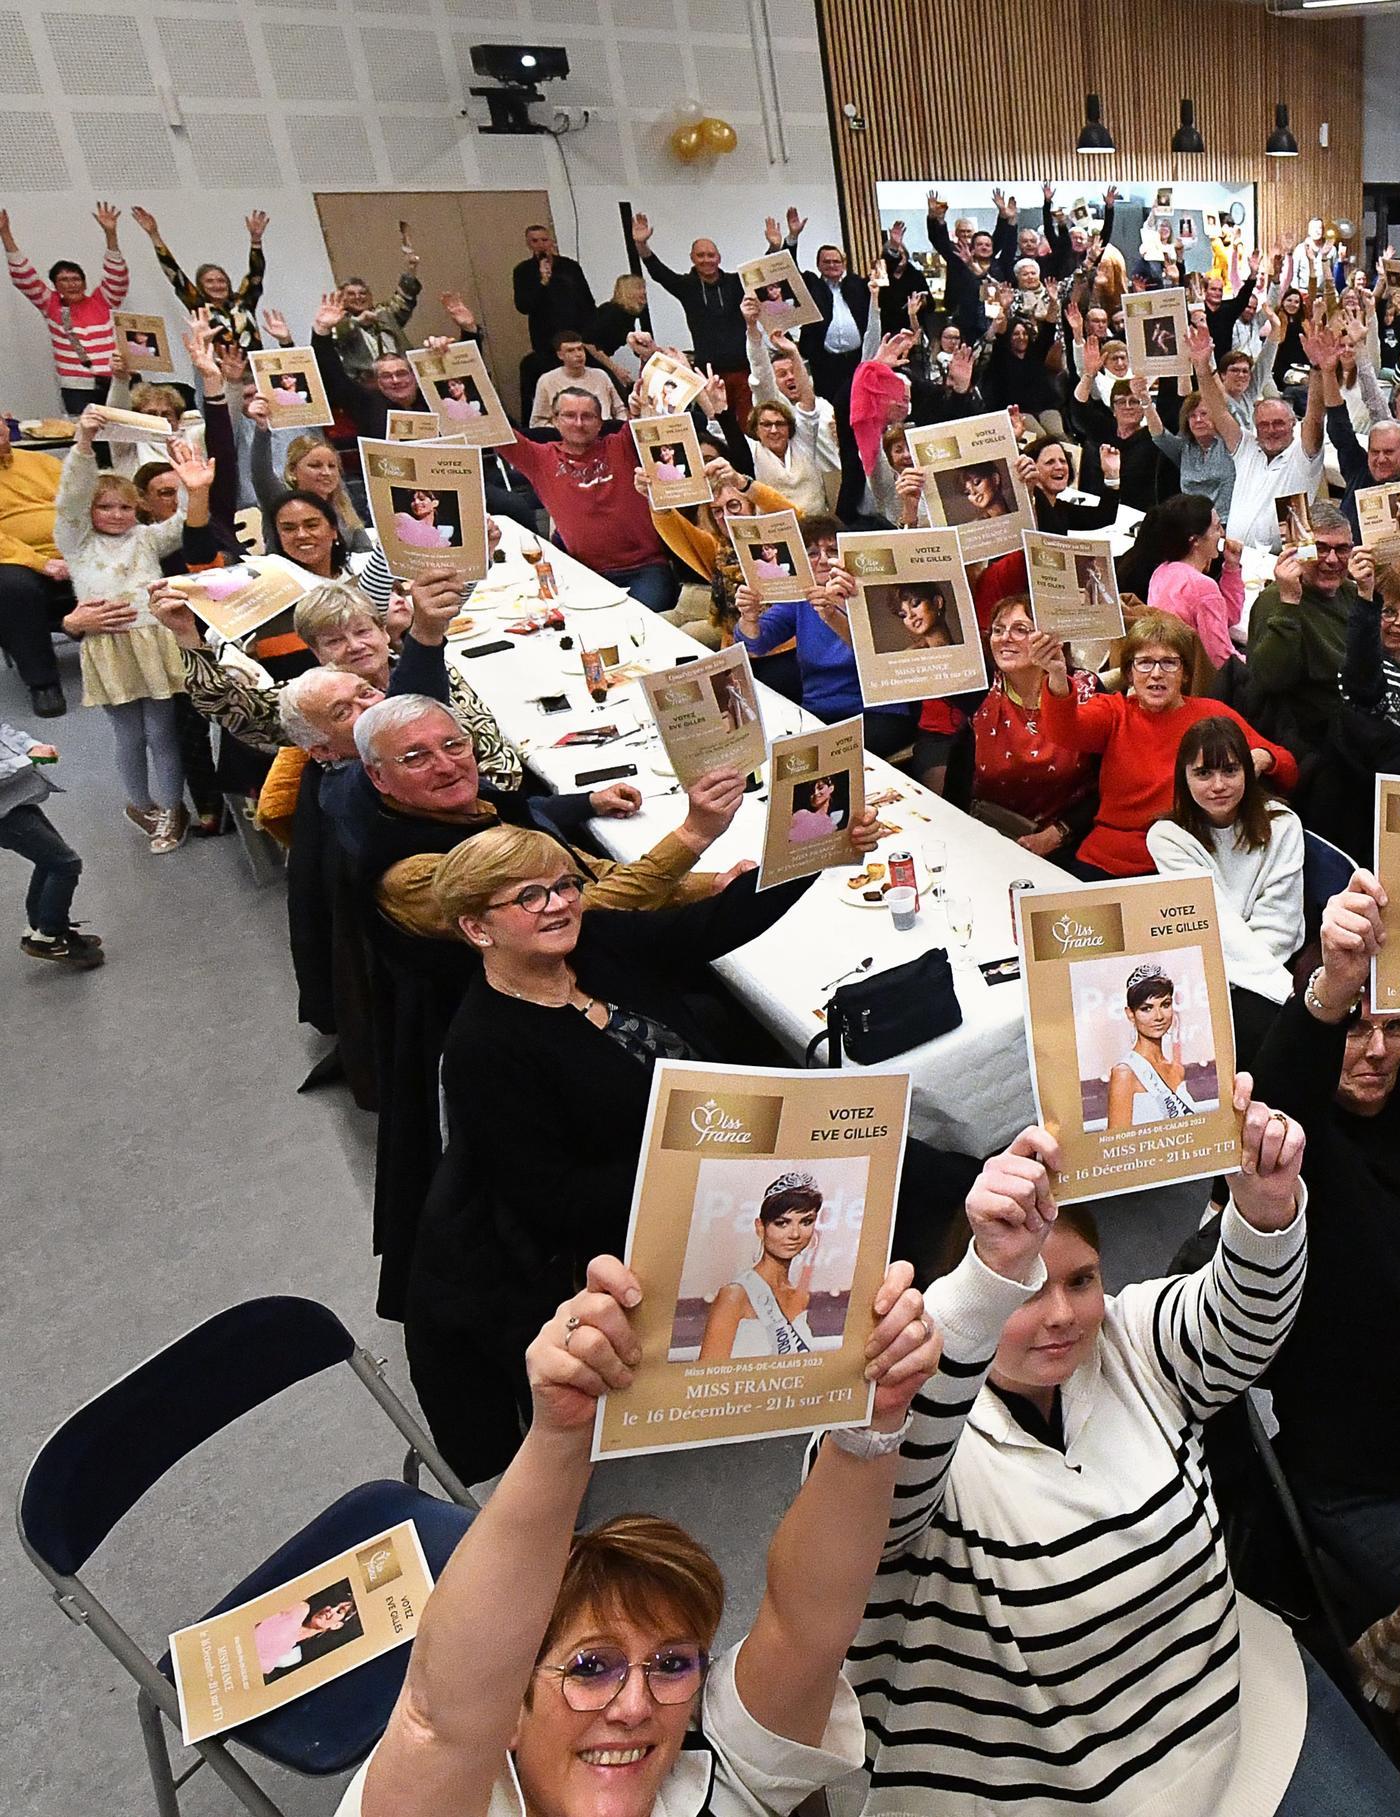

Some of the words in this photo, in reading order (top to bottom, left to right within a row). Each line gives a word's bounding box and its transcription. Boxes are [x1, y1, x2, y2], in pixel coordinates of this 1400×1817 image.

[926, 555, 952, 563] GILLES
[1159, 905, 1195, 919] VOTEZ
[1052, 919, 1095, 942] Miss
[1150, 925, 1174, 937] EVE
[1176, 920, 1209, 933] GILLES
[1061, 933, 1105, 954] france
[690, 1103, 743, 1130] Miss
[829, 1107, 874, 1121] VOTEZ
[696, 1119, 752, 1146] france
[811, 1128, 840, 1142] EVE
[843, 1125, 888, 1140] GILLES
[1103, 1147, 1136, 1160] MISS
[1139, 1132, 1194, 1152] FRANCE
[1058, 1172, 1070, 1183] le
[1076, 1169, 1089, 1180] 16
[1092, 1157, 1156, 1177] Décembre
[1167, 1152, 1179, 1163] 21
[1182, 1151, 1190, 1161] h
[1193, 1146, 1211, 1157] sur
[684, 1368, 705, 1378] Miss
[706, 1359, 801, 1376] NORD-PAS-DE-CALAIS
[685, 1382, 730, 1400] MISS
[734, 1375, 805, 1395] FRANCE
[622, 1411, 639, 1426] le
[647, 1409, 664, 1424] 16
[668, 1399, 752, 1421] Décembre
[766, 1397, 781, 1411] 21
[785, 1397, 795, 1409] h
[800, 1395, 823, 1407] sur
[385, 1595, 396, 1610] EVE
[400, 1596, 414, 1620] VOTEZ
[390, 1609, 404, 1634] GILLES
